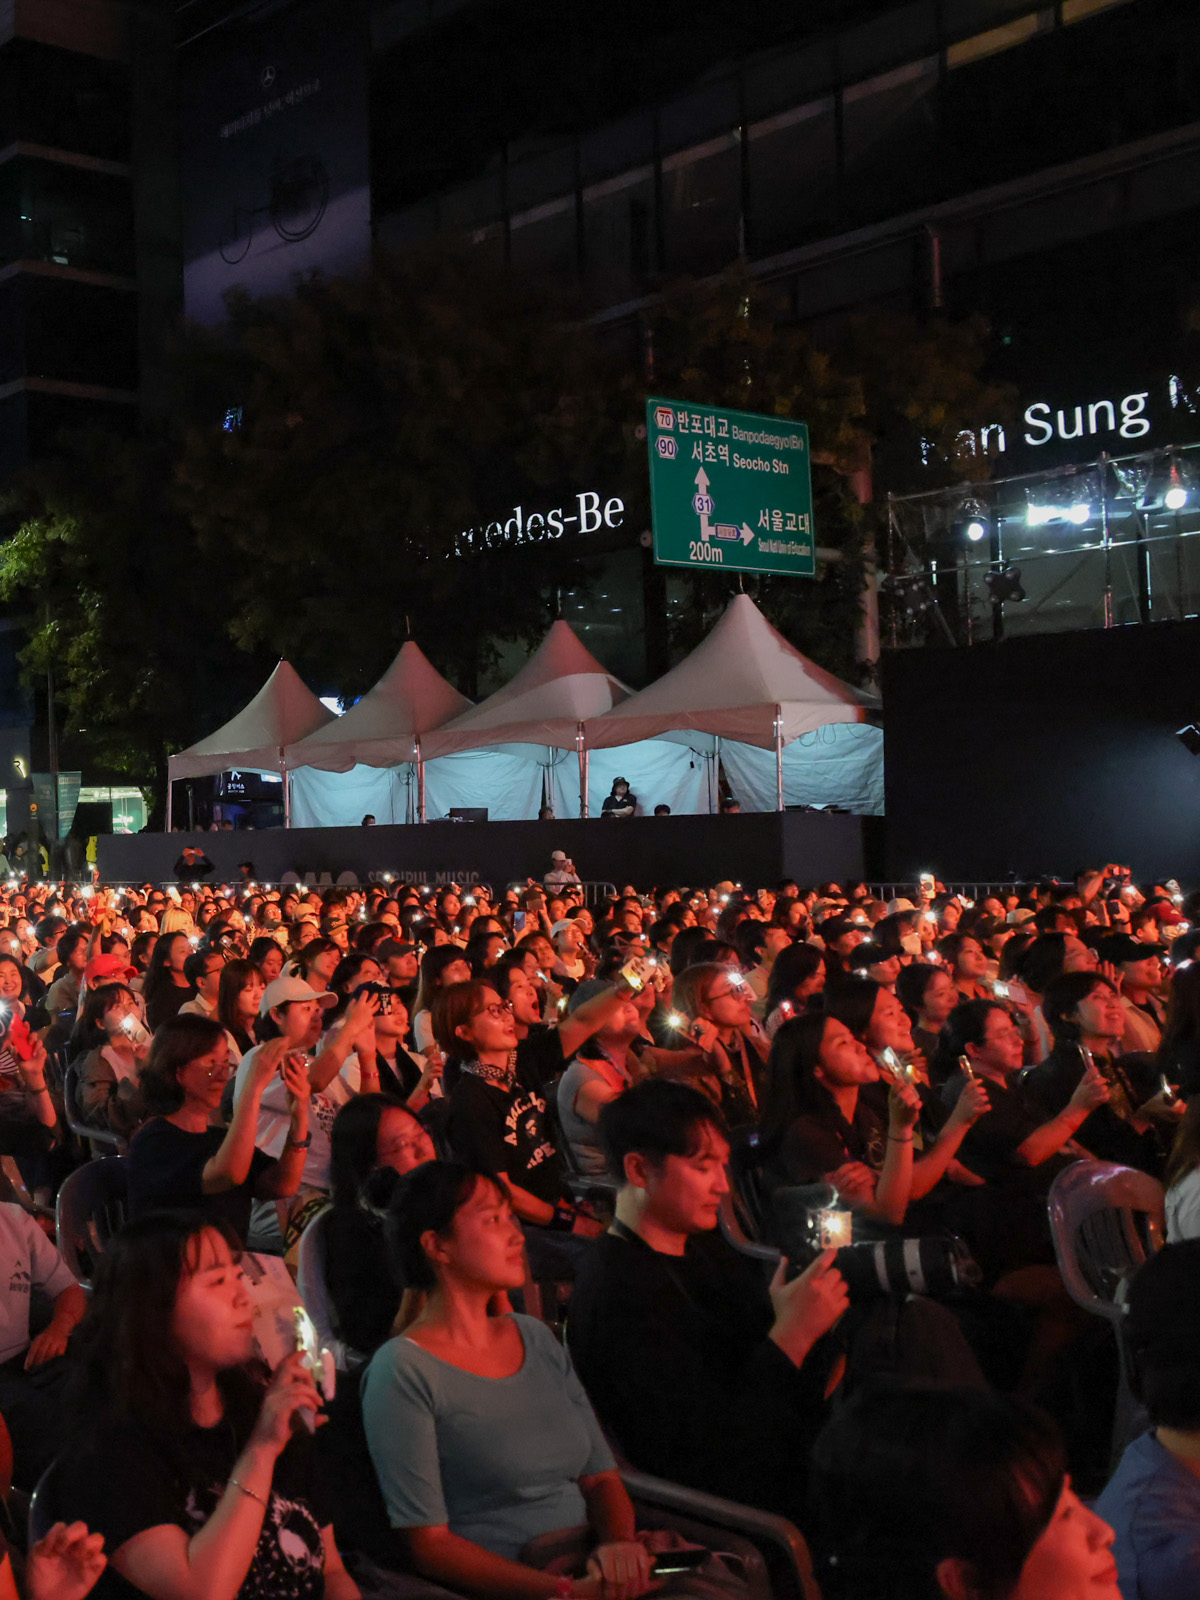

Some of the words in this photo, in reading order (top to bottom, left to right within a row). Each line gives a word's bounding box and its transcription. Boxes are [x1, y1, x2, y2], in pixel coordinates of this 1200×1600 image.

[660, 413, 671, 426] 70
[677, 411, 729, 438] 반포대교
[1024, 391, 1150, 446] Sung
[660, 439, 674, 455] 90
[691, 440, 730, 467] 서초역
[733, 453, 770, 472] Seocho
[772, 458, 790, 474] Stn
[697, 497, 710, 512] 31
[453, 491, 625, 557] edes-Be
[758, 508, 810, 535] 서울교대
[689, 541, 723, 562] 200m
